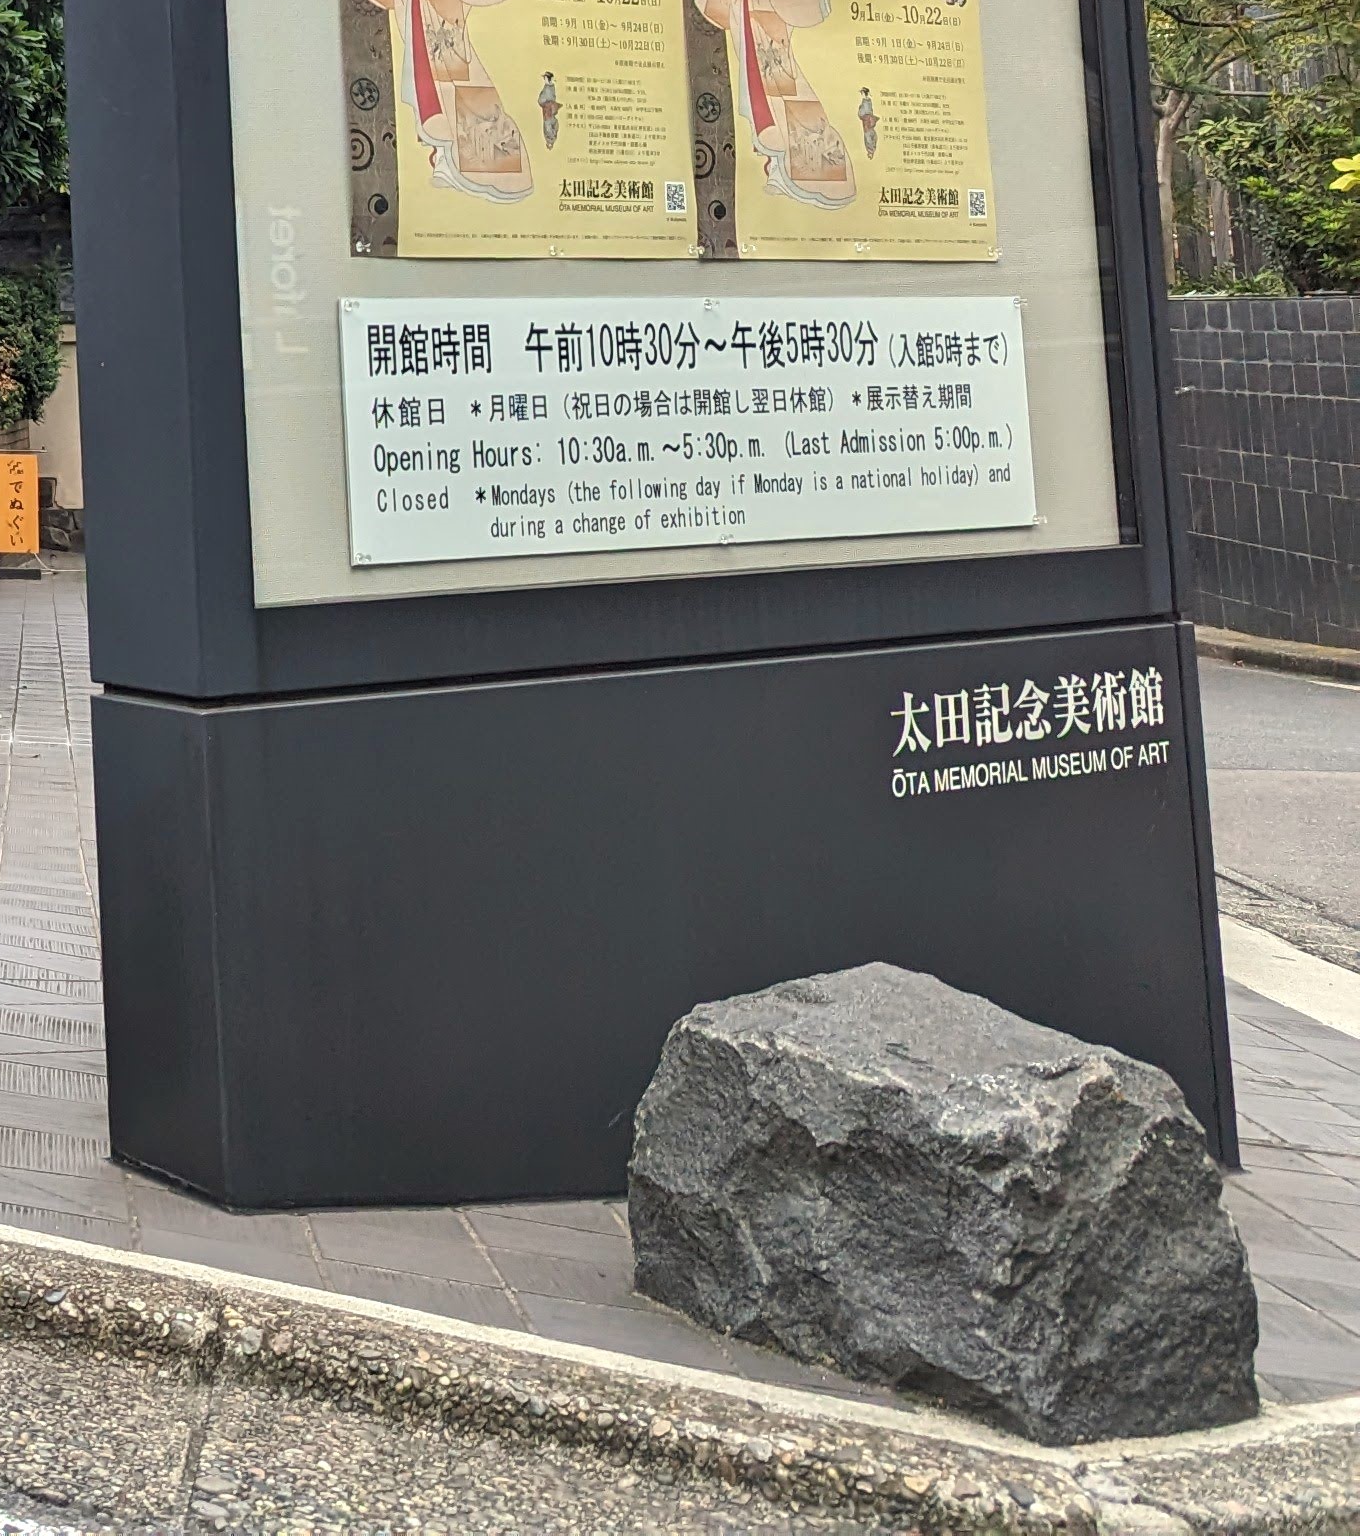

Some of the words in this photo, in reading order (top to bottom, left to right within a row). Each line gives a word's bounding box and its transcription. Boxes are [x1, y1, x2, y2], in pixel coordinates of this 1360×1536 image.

[559, 178, 654, 200] 太田記念美術館
[572, 204, 605, 213] MEMORIAL
[605, 205, 632, 213] MUSEUM
[633, 205, 642, 213] OF
[643, 205, 654, 213] ART
[878, 186, 959, 206] 太田記念美術館
[367, 322, 492, 377] 開館時間
[371, 396, 446, 429] 休館日
[373, 443, 461, 477] Opening
[472, 439, 543, 469] Hours:
[784, 430, 831, 459] (Last
[840, 428, 926, 455] Admission
[934, 423, 1014, 454] 5:00p.m.)
[376, 485, 449, 513] Closed
[568, 478, 601, 506] (the
[609, 478, 689, 504] following
[695, 475, 721, 500] day
[731, 473, 745, 495] if
[754, 470, 803, 496] Monday
[813, 469, 828, 492] is
[835, 475, 844, 491] a
[851, 466, 913, 490] national
[920, 463, 980, 488] holiday)
[988, 462, 1012, 484] and
[490, 515, 546, 540] during
[554, 518, 564, 535] a
[572, 511, 626, 537] change
[635, 509, 651, 531] of
[660, 505, 746, 530] exhibition
[890, 666, 1164, 758] 太田記念美術館
[934, 759, 1028, 793] MEMORIAL
[1032, 749, 1107, 781] MUSEUM
[1110, 746, 1133, 770] OF
[1138, 740, 1170, 766] ART
